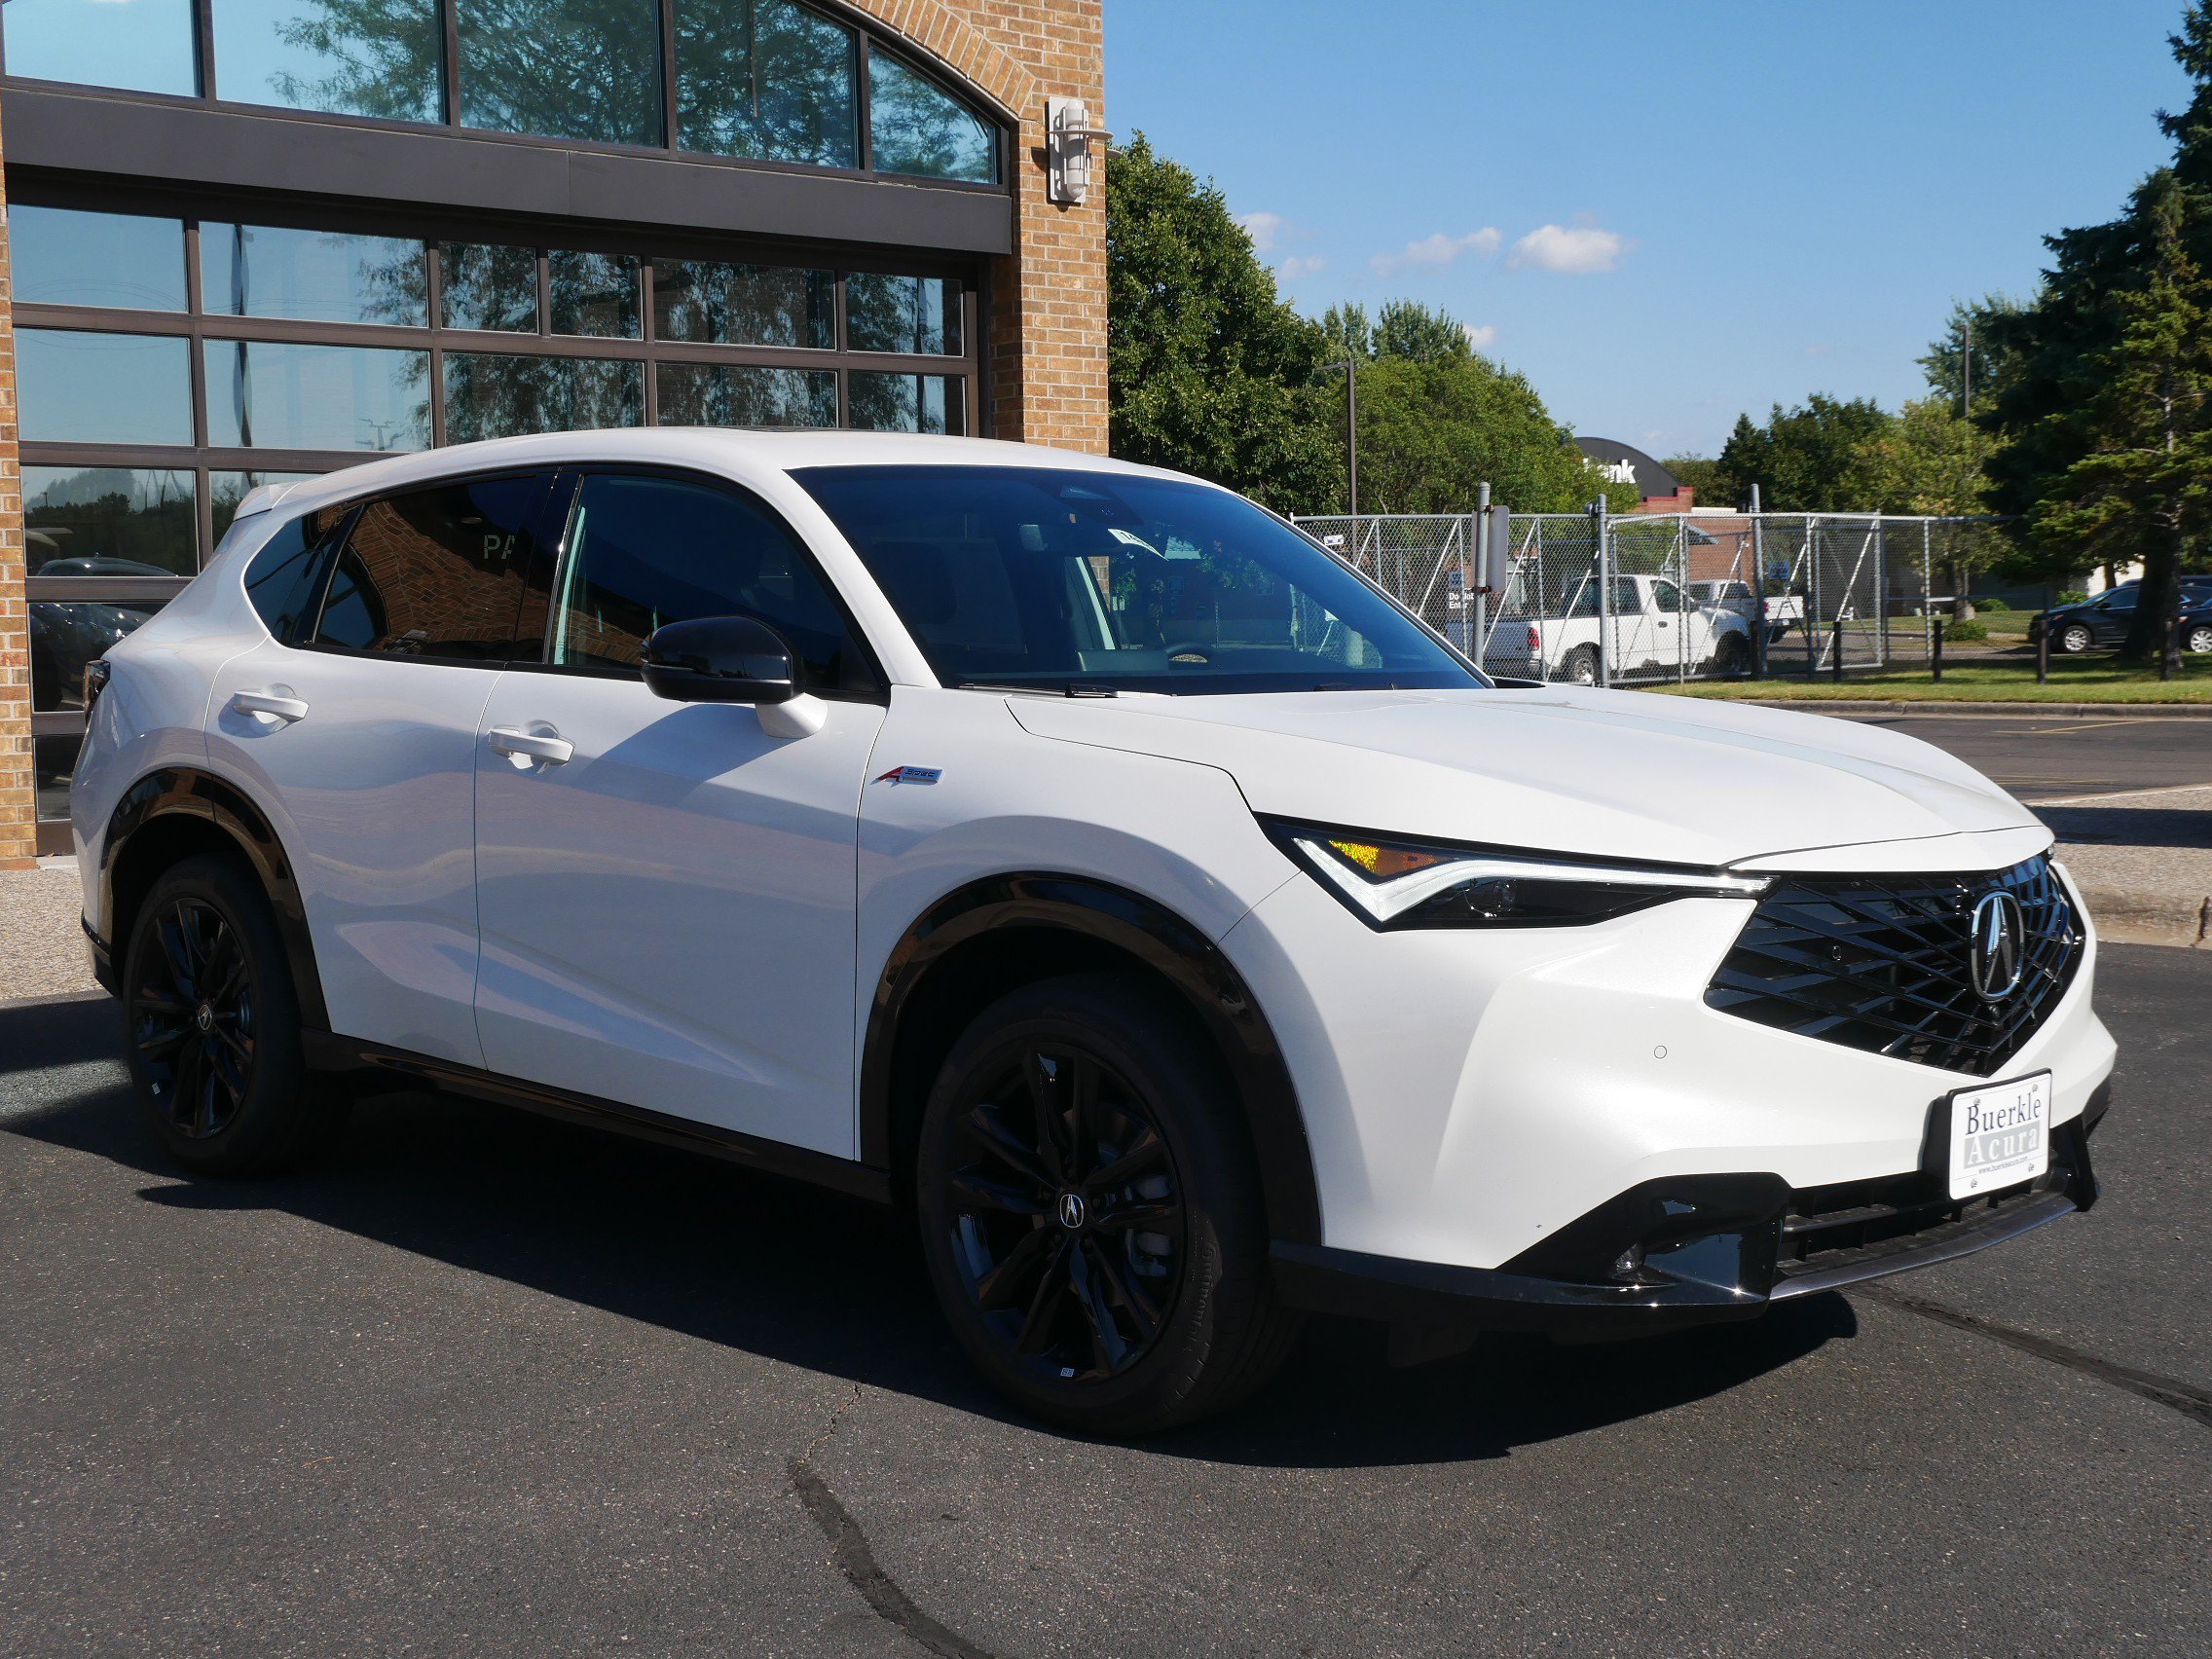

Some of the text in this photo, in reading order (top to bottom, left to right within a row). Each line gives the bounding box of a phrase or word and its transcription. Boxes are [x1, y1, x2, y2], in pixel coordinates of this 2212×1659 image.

[1582, 457, 1637, 485] ank
[1449, 601, 1468, 609] Entr
[1965, 1091, 2042, 1136] Buerkle
[1966, 1126, 2039, 1166] Acura
